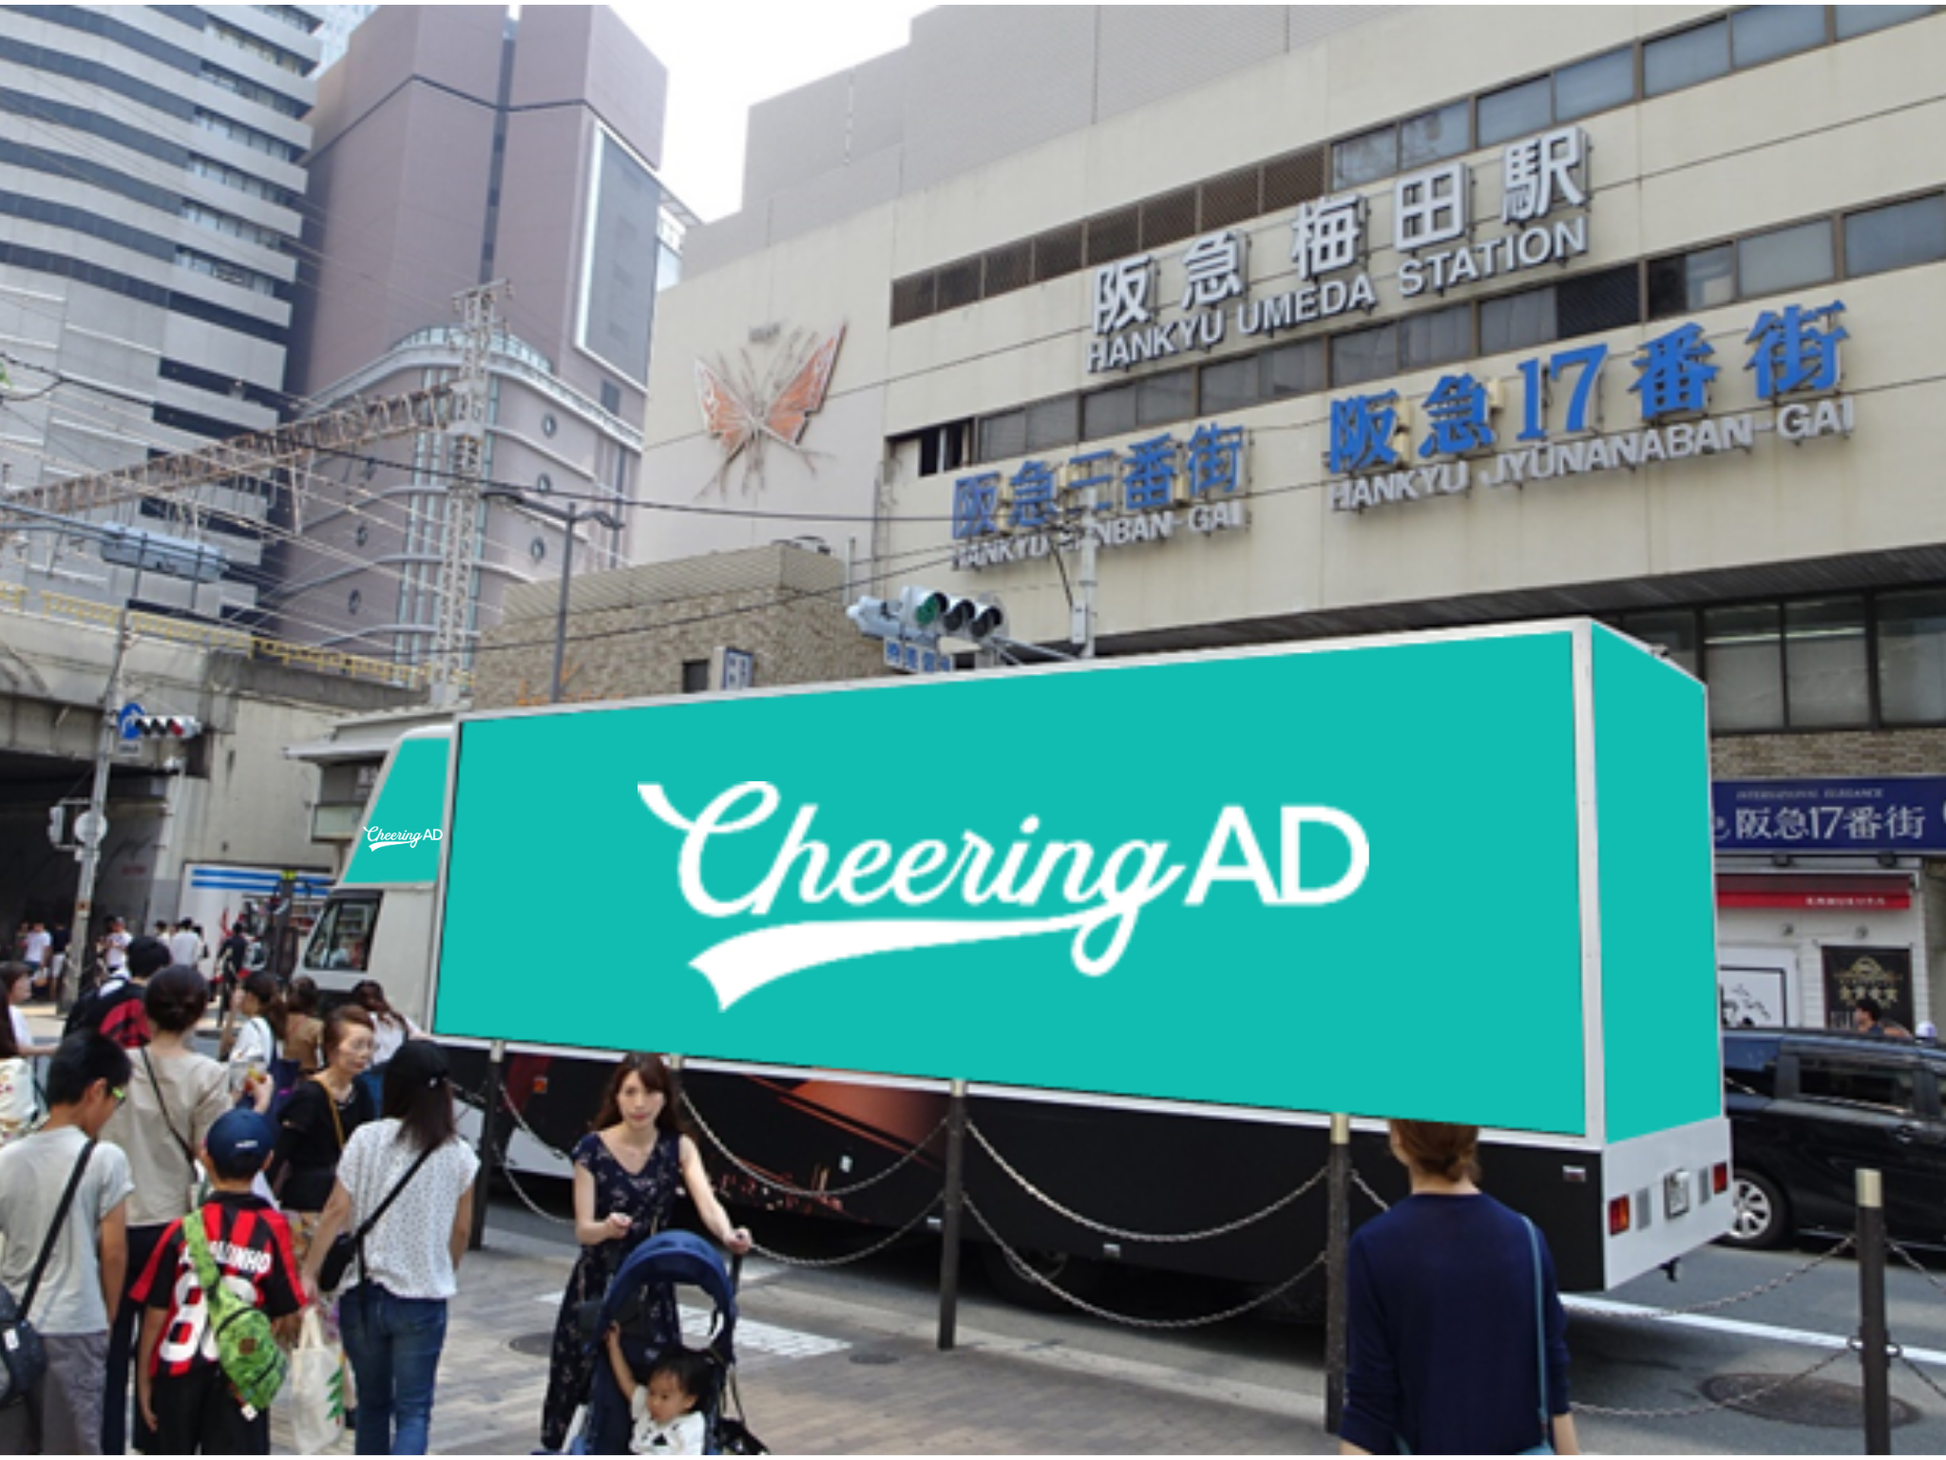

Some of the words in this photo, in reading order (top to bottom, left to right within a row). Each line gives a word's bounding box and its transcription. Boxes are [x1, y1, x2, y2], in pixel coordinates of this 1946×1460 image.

[1087, 308, 1225, 373] HANKYU
[1236, 273, 1377, 336] UMEDA
[1398, 215, 1588, 297] STATION
[1091, 125, 1590, 335] 阪急梅田駅
[1328, 299, 1848, 474] 阪急17番街
[1330, 460, 1469, 510] HANKYU
[363, 826, 423, 852] Cheering
[423, 829, 443, 840] AD
[637, 780, 1187, 1012] Cheering
[1183, 805, 1370, 905] AD
[1735, 805, 1926, 840] 阪急17番街
